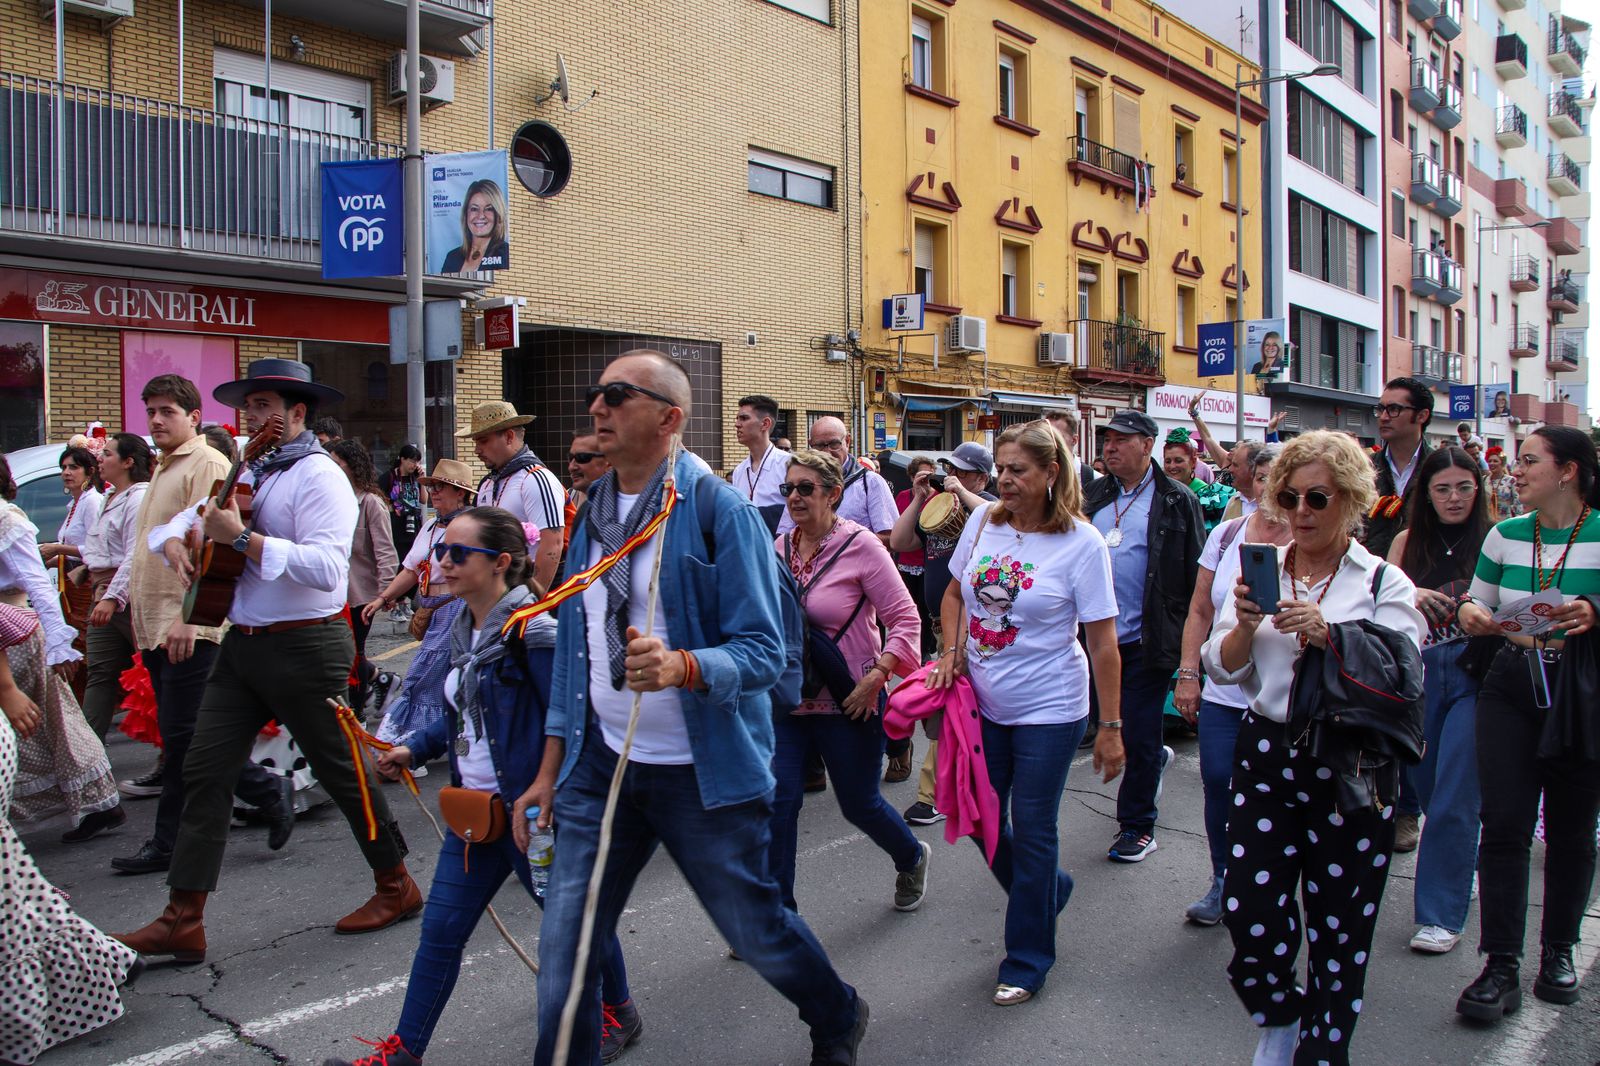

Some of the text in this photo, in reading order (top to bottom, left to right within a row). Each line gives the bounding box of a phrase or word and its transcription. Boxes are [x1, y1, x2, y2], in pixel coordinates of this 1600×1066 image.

[338, 194, 386, 211] VOTA
[481, 256, 502, 265] 28M
[94, 285, 256, 327] GENERALI
[1204, 338, 1226, 346] VOTA
[1155, 392, 1191, 409] FARMACIA
[1203, 396, 1235, 413] ESTACIÓN
